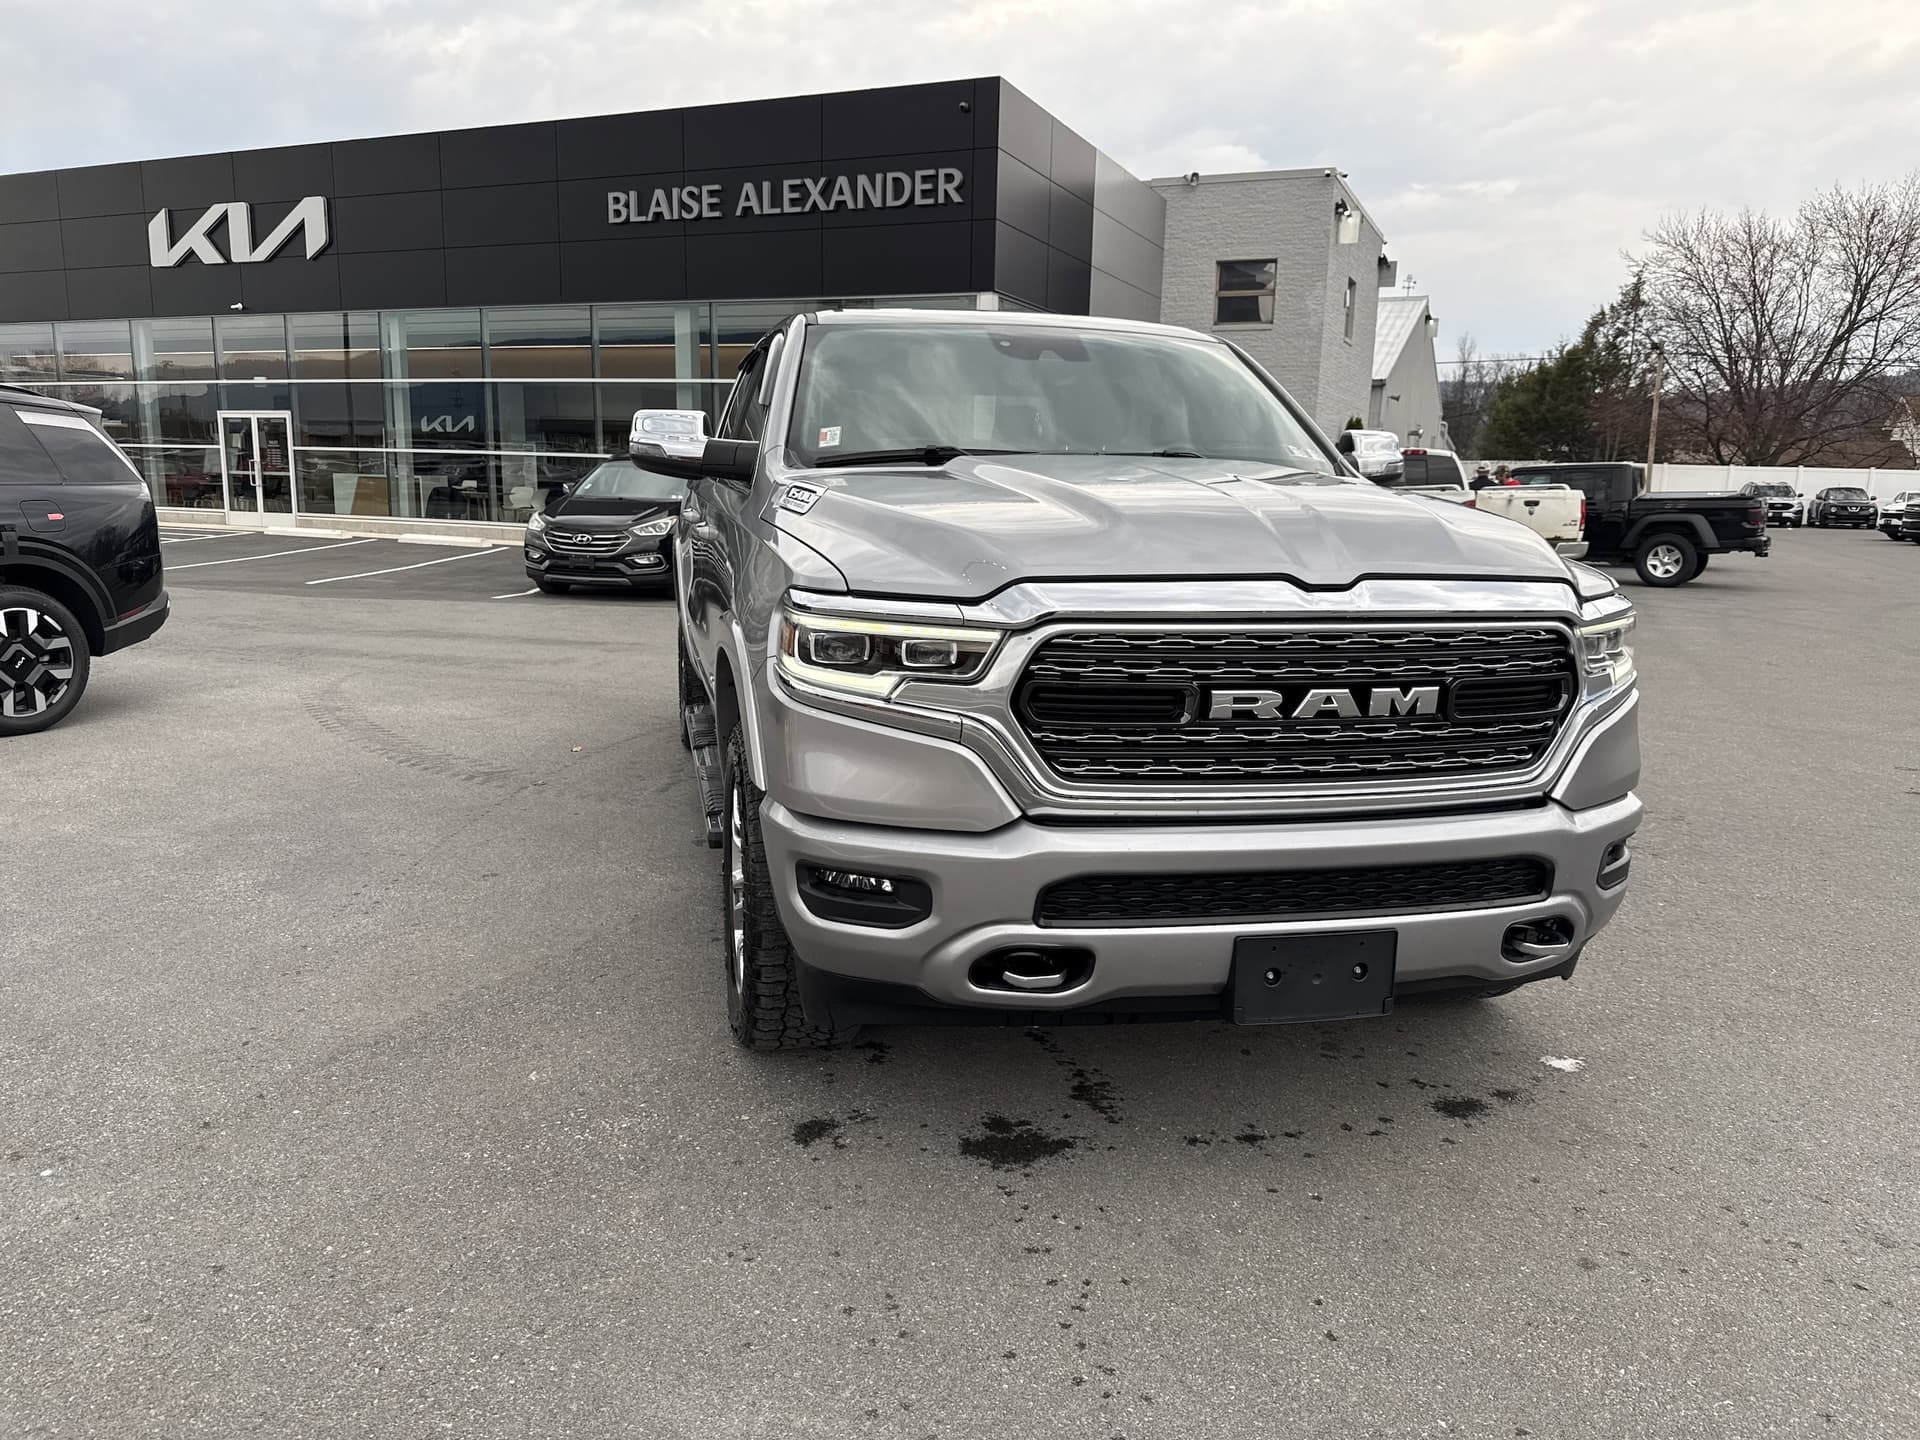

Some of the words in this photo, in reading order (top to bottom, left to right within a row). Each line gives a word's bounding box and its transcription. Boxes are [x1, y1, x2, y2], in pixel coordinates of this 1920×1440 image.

[607, 184, 723, 225] BLAISE
[735, 167, 965, 217] ALEXANDER
[148, 195, 329, 268] KIA
[420, 415, 475, 433] KIA
[1208, 686, 1440, 720] RAM
